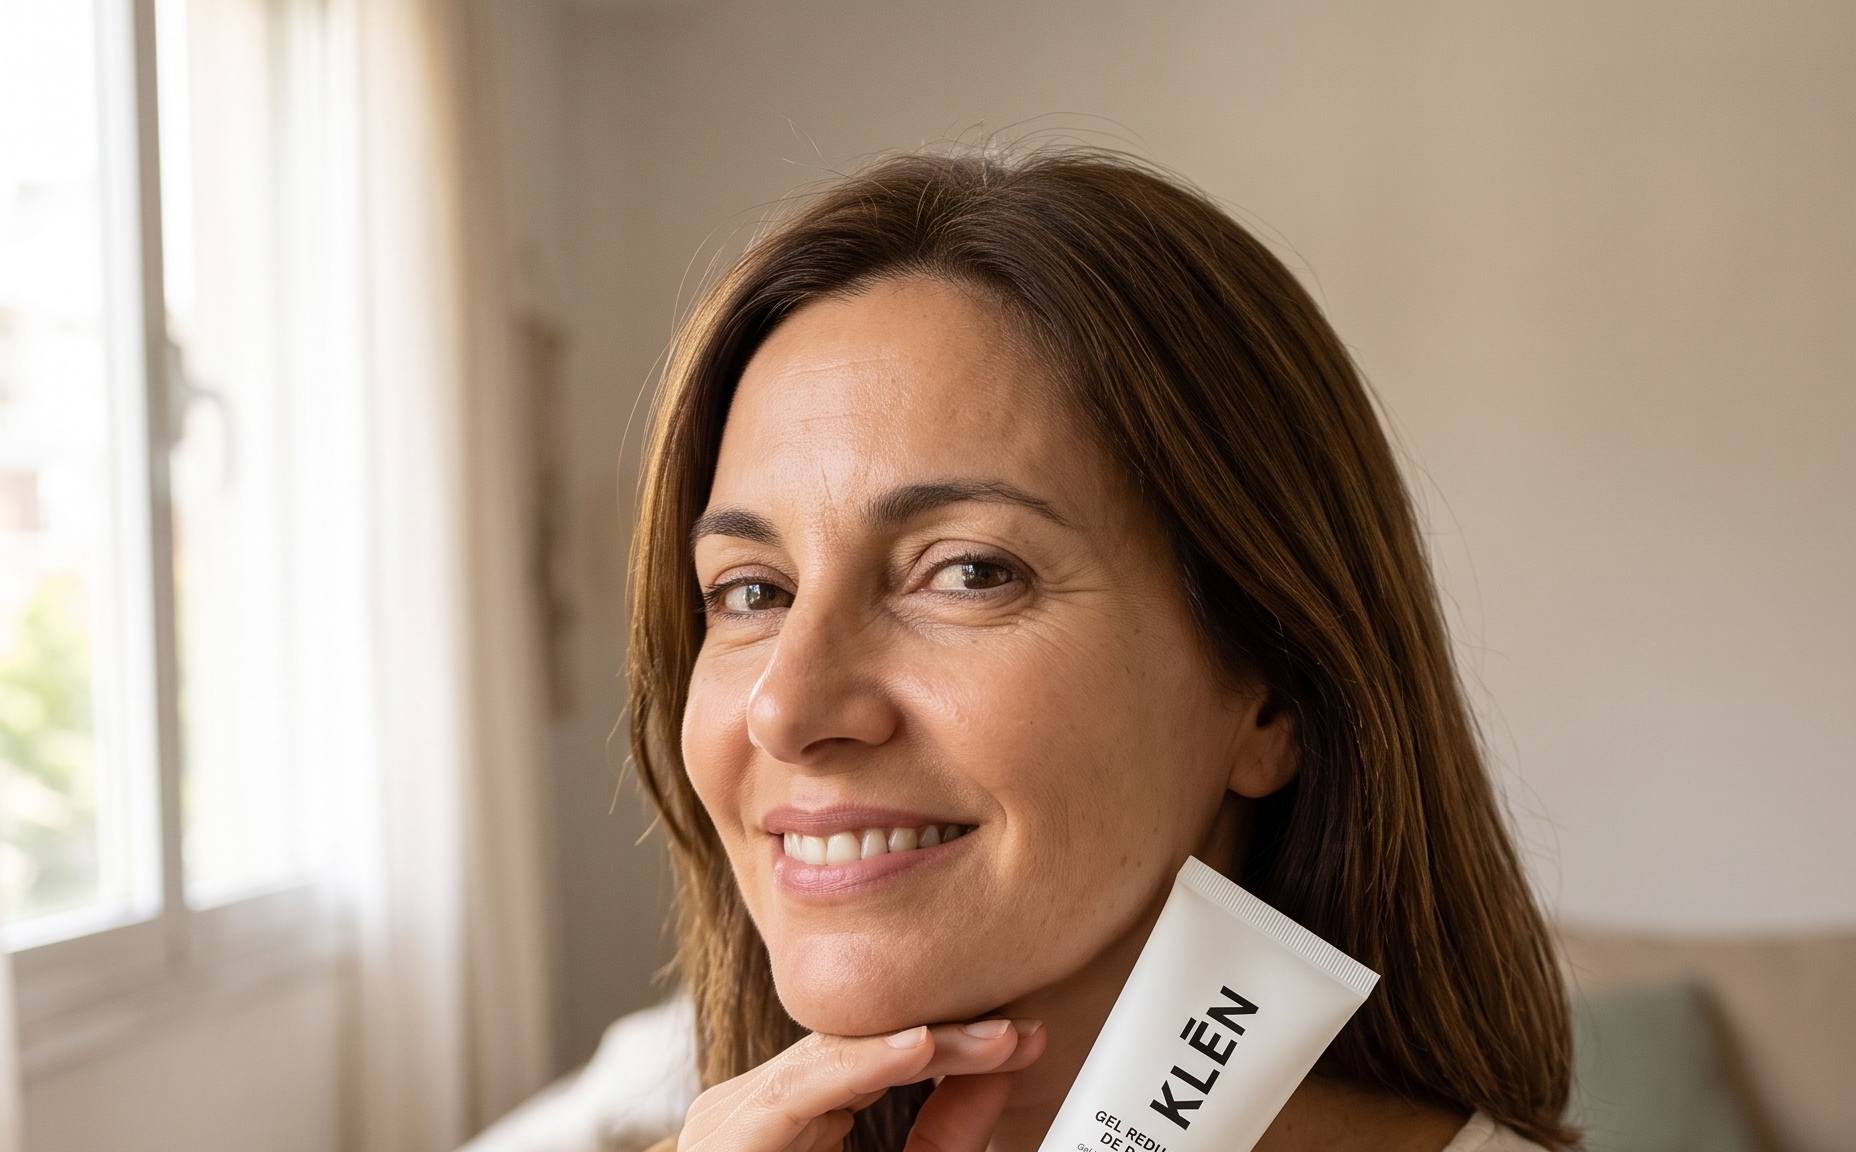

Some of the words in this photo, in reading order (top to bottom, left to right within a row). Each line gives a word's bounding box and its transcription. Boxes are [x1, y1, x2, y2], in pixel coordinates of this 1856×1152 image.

[1150, 985, 1259, 1130] KLĒN
[1095, 1111, 1122, 1133] GEL
[1100, 1132, 1123, 1151] DE
